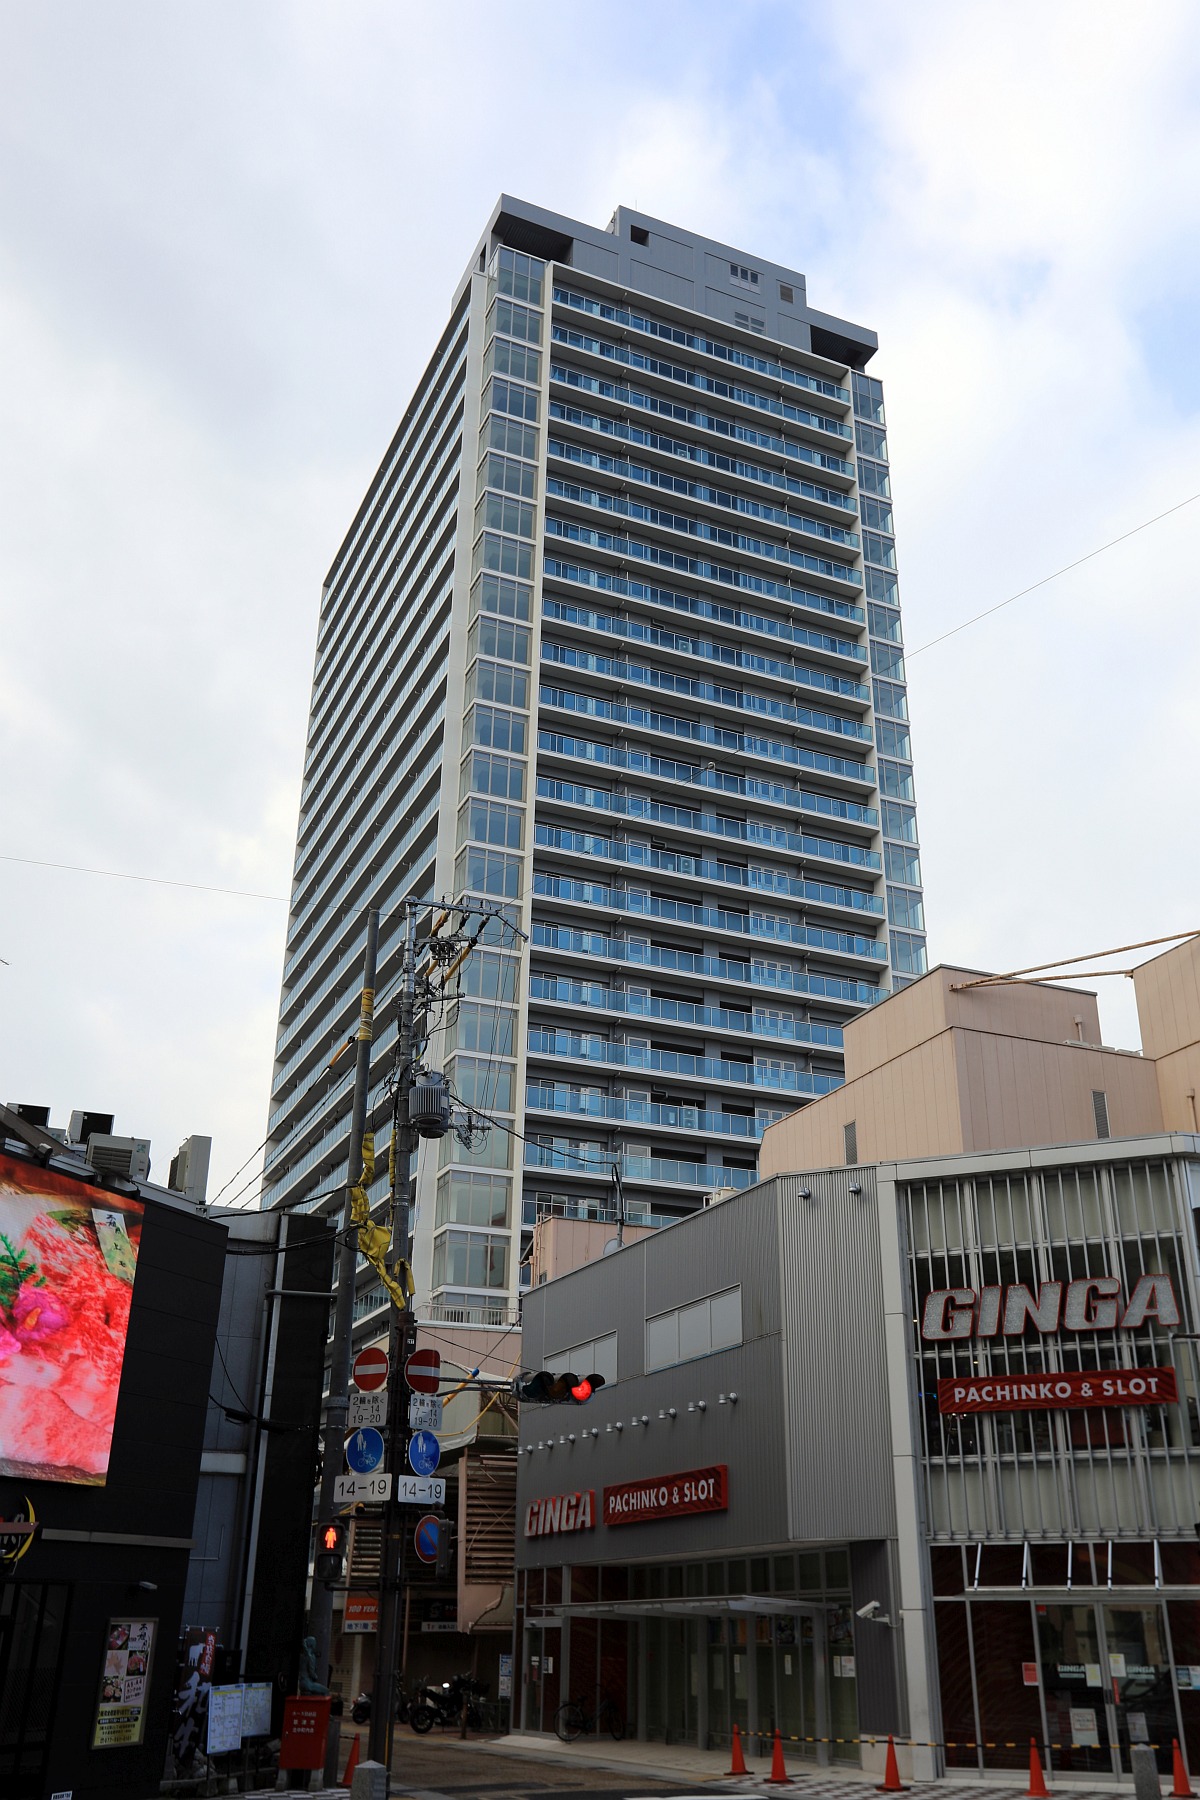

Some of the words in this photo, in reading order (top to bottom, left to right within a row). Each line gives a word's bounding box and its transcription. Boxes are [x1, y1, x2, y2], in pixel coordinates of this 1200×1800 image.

[922, 1274, 1181, 1340] GINGA
[954, 1382, 1071, 1403] PACHINKO
[1080, 1383, 1093, 1397] &
[1103, 1377, 1158, 1396] SLOT
[353, 1414, 380, 1424] 19-20
[339, 1479, 387, 1497] 14-19
[403, 1482, 442, 1499] 14-19
[609, 1486, 668, 1514] PACHINKO
[672, 1486, 680, 1504] &
[683, 1478, 715, 1503] SLOT
[524, 1489, 596, 1537] GINGA
[1057, 1664, 1085, 1673] GINGA
[1127, 1665, 1155, 1673] GINGA
